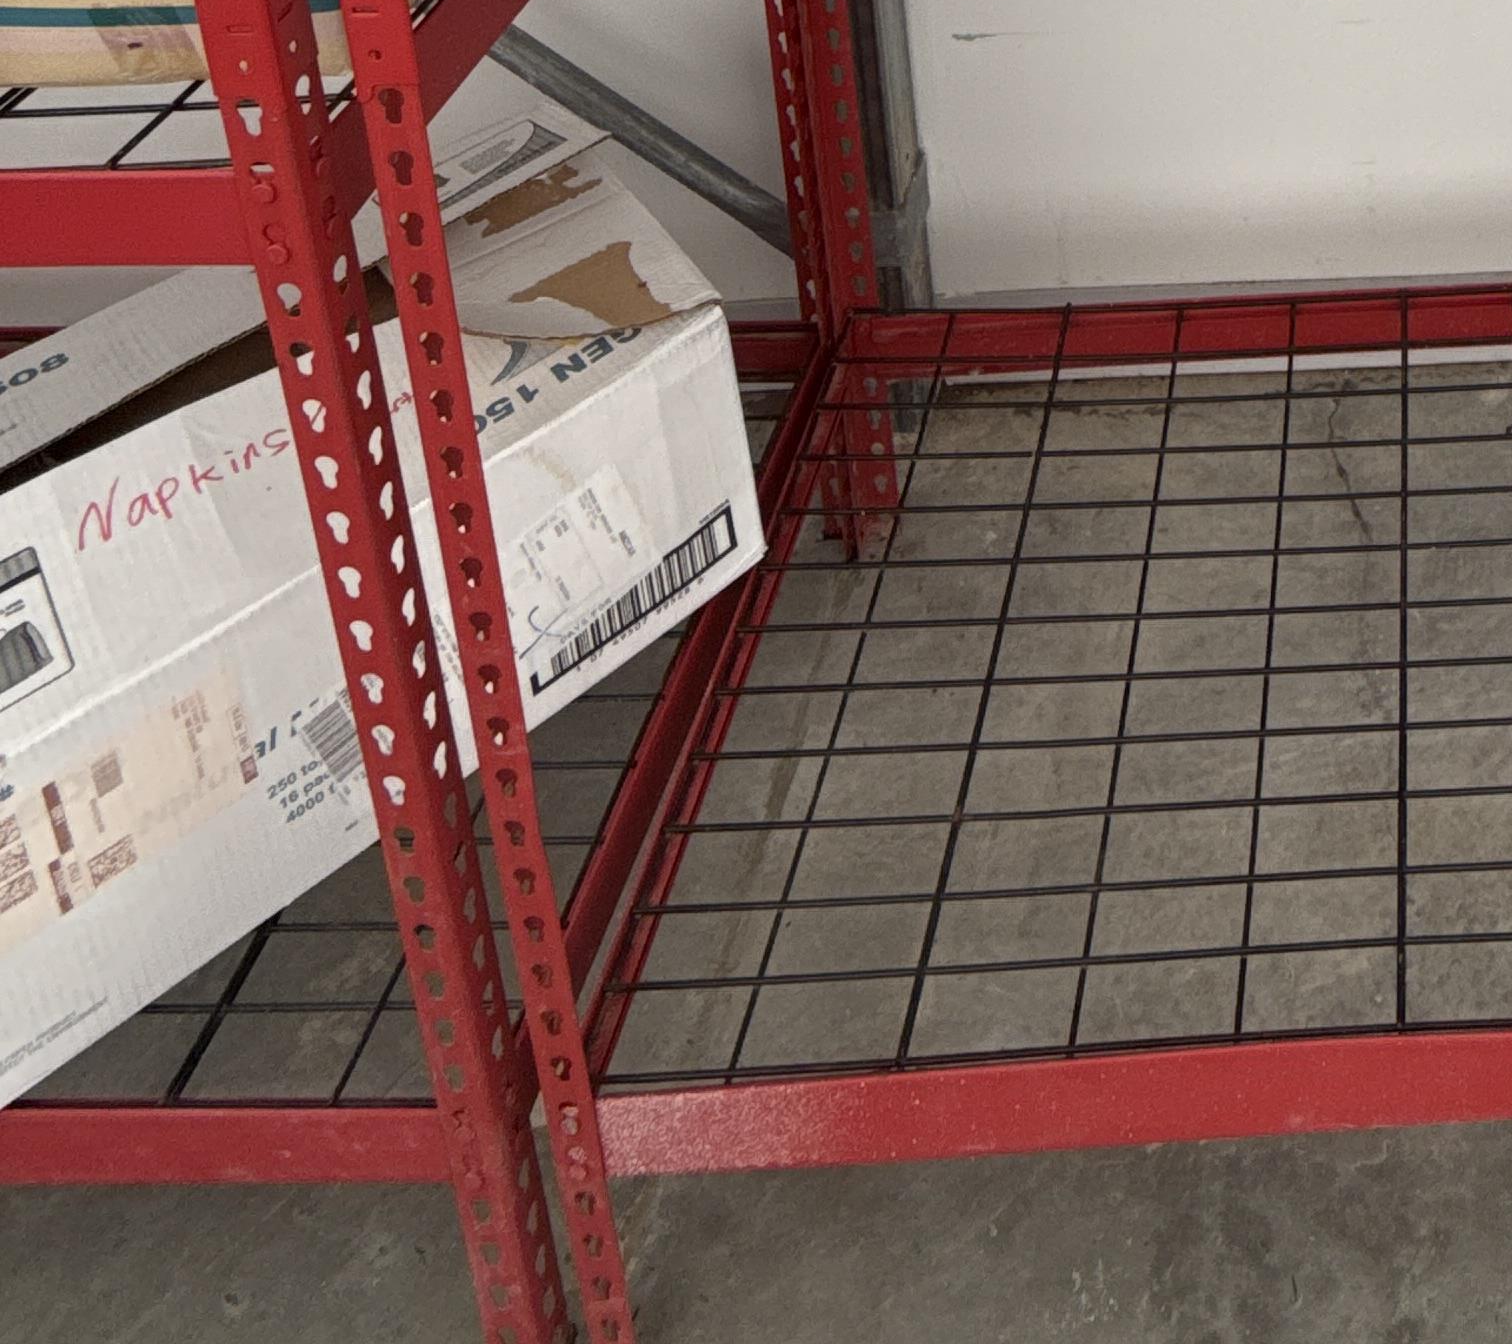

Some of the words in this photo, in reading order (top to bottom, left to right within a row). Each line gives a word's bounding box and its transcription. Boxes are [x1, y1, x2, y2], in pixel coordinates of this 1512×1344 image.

[75, 427, 292, 554] Napkins
[267, 772, 298, 800] 250
[285, 790, 325, 824] 4000
